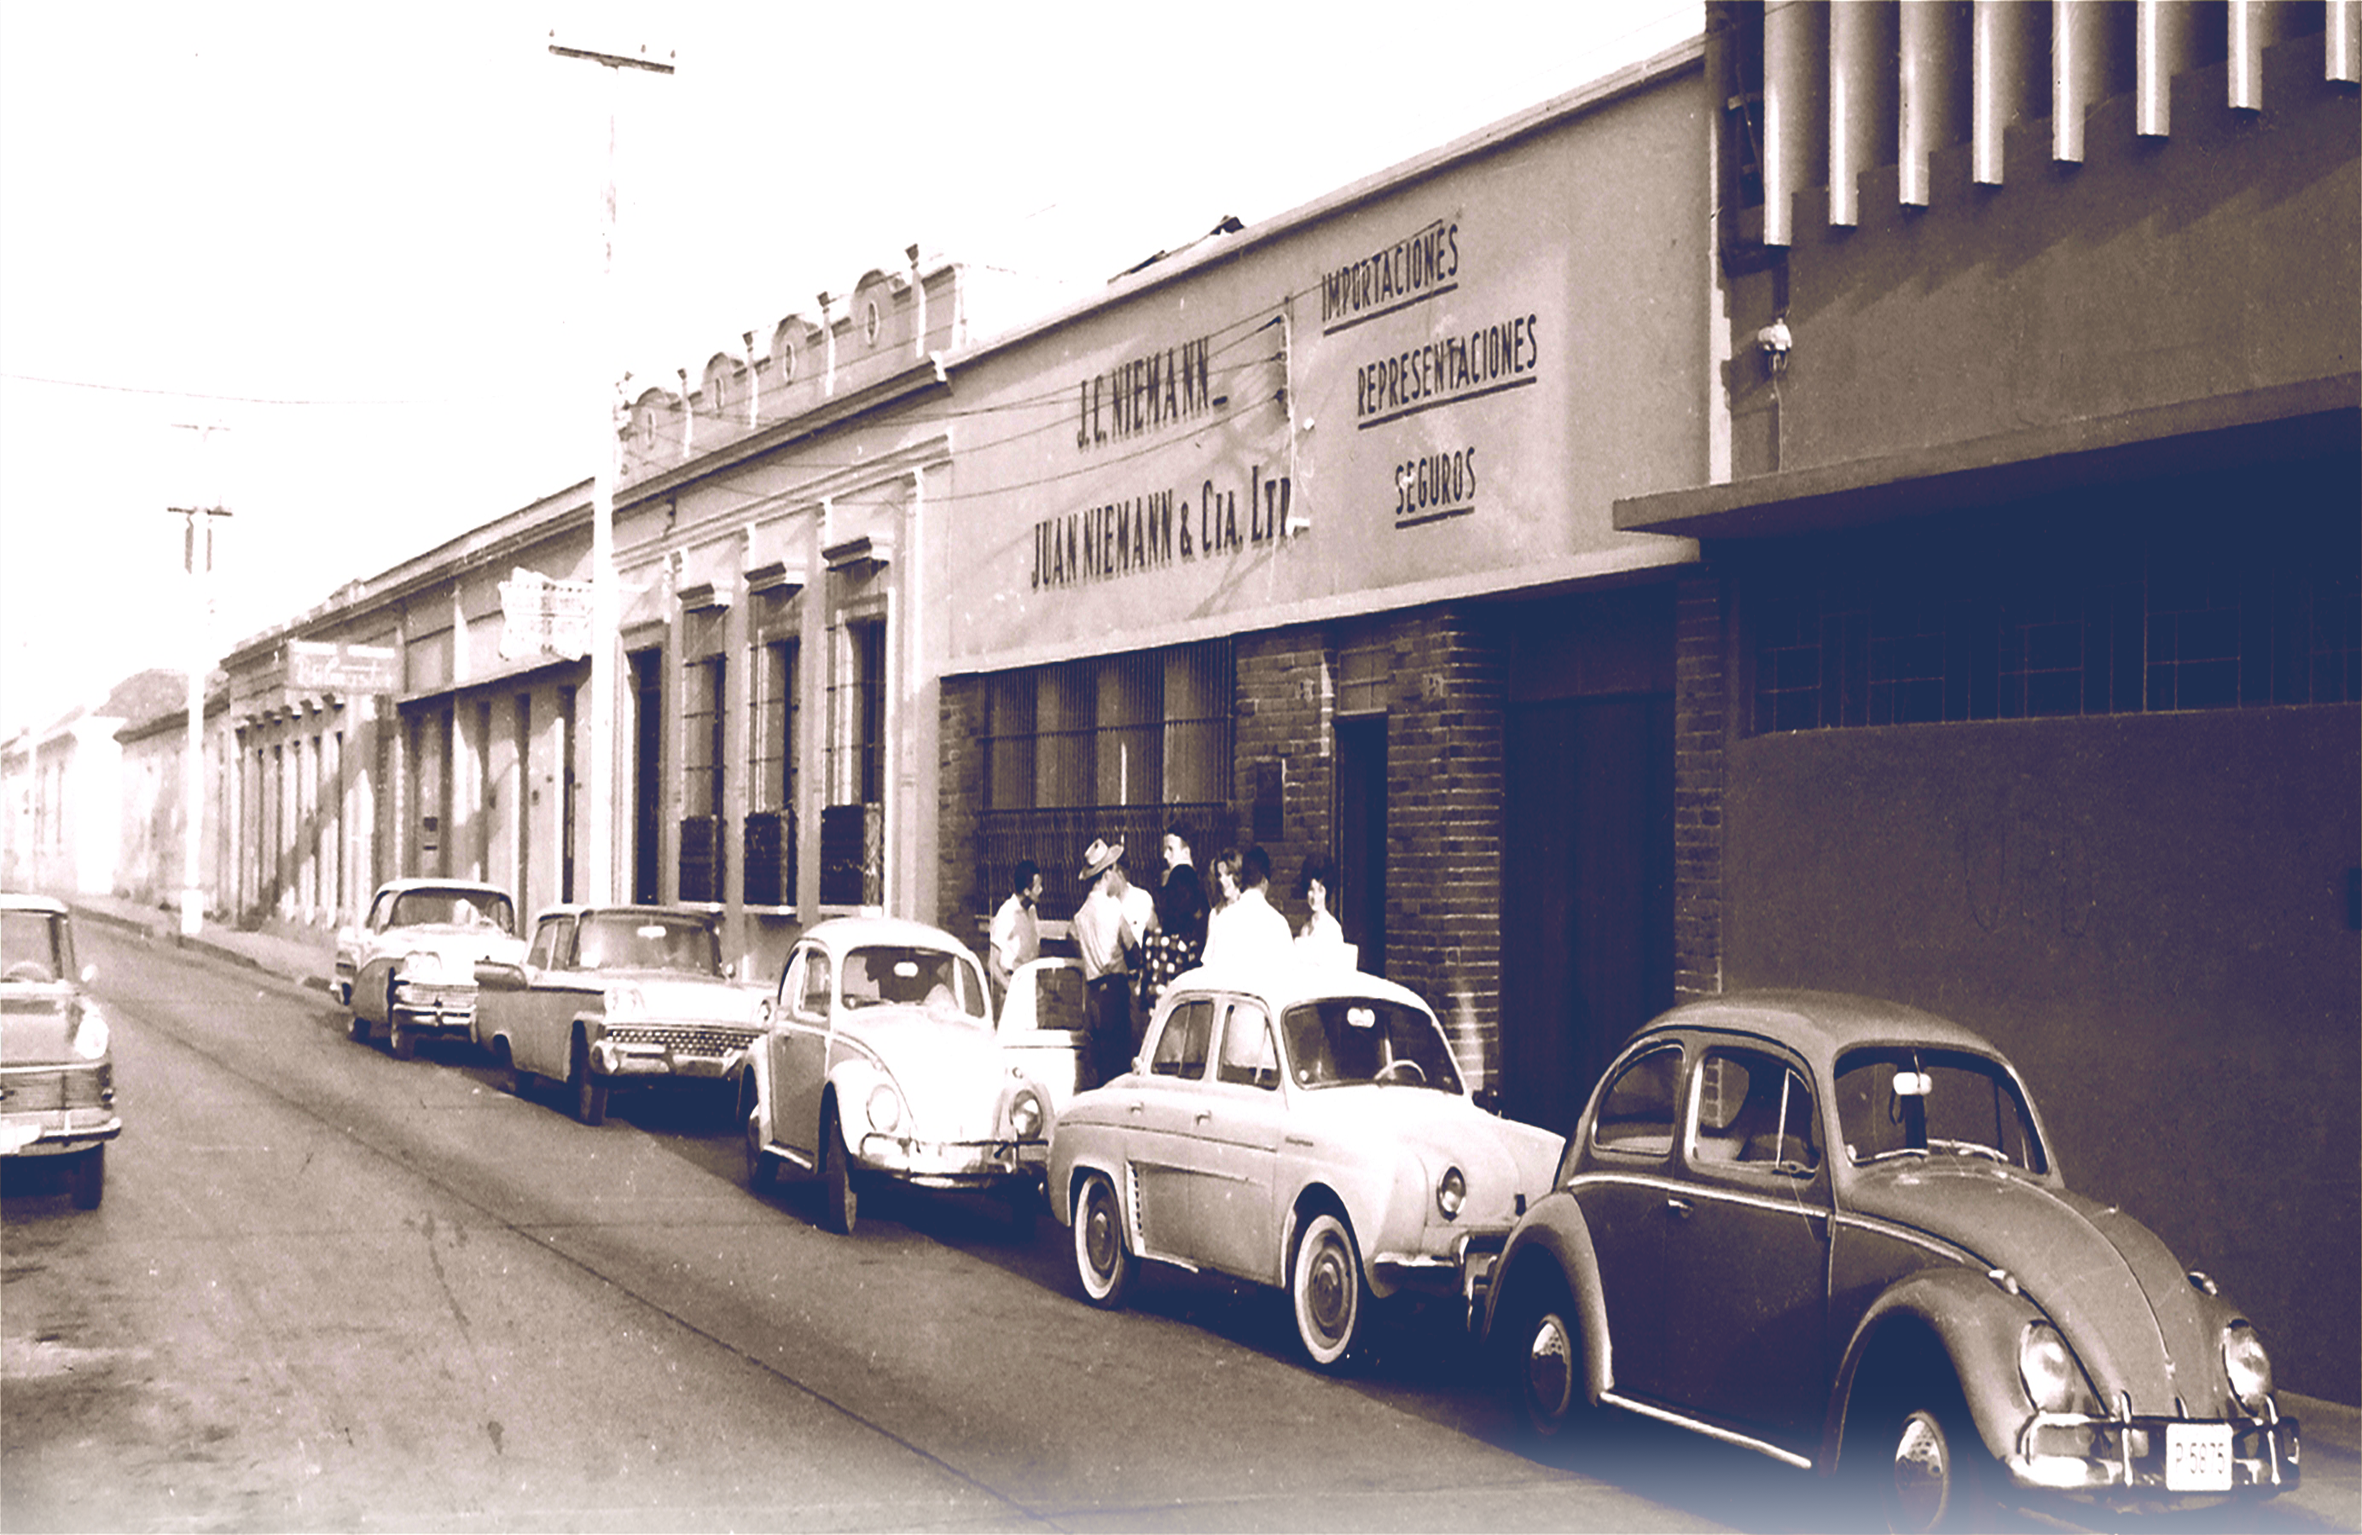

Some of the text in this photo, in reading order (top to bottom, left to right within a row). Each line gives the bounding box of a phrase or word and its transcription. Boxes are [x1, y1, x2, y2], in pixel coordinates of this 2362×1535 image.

[1321, 224, 1458, 322] IMPORTACIONES
[1112, 335, 1210, 437] NIEMANN
[1357, 314, 1537, 417] REPRESENTACIONES
[1395, 447, 1475, 515] SEGUROS
[1031, 513, 1077, 589] JUAN
[1083, 488, 1173, 579] NIEMANN
[1180, 501, 1193, 557] &
